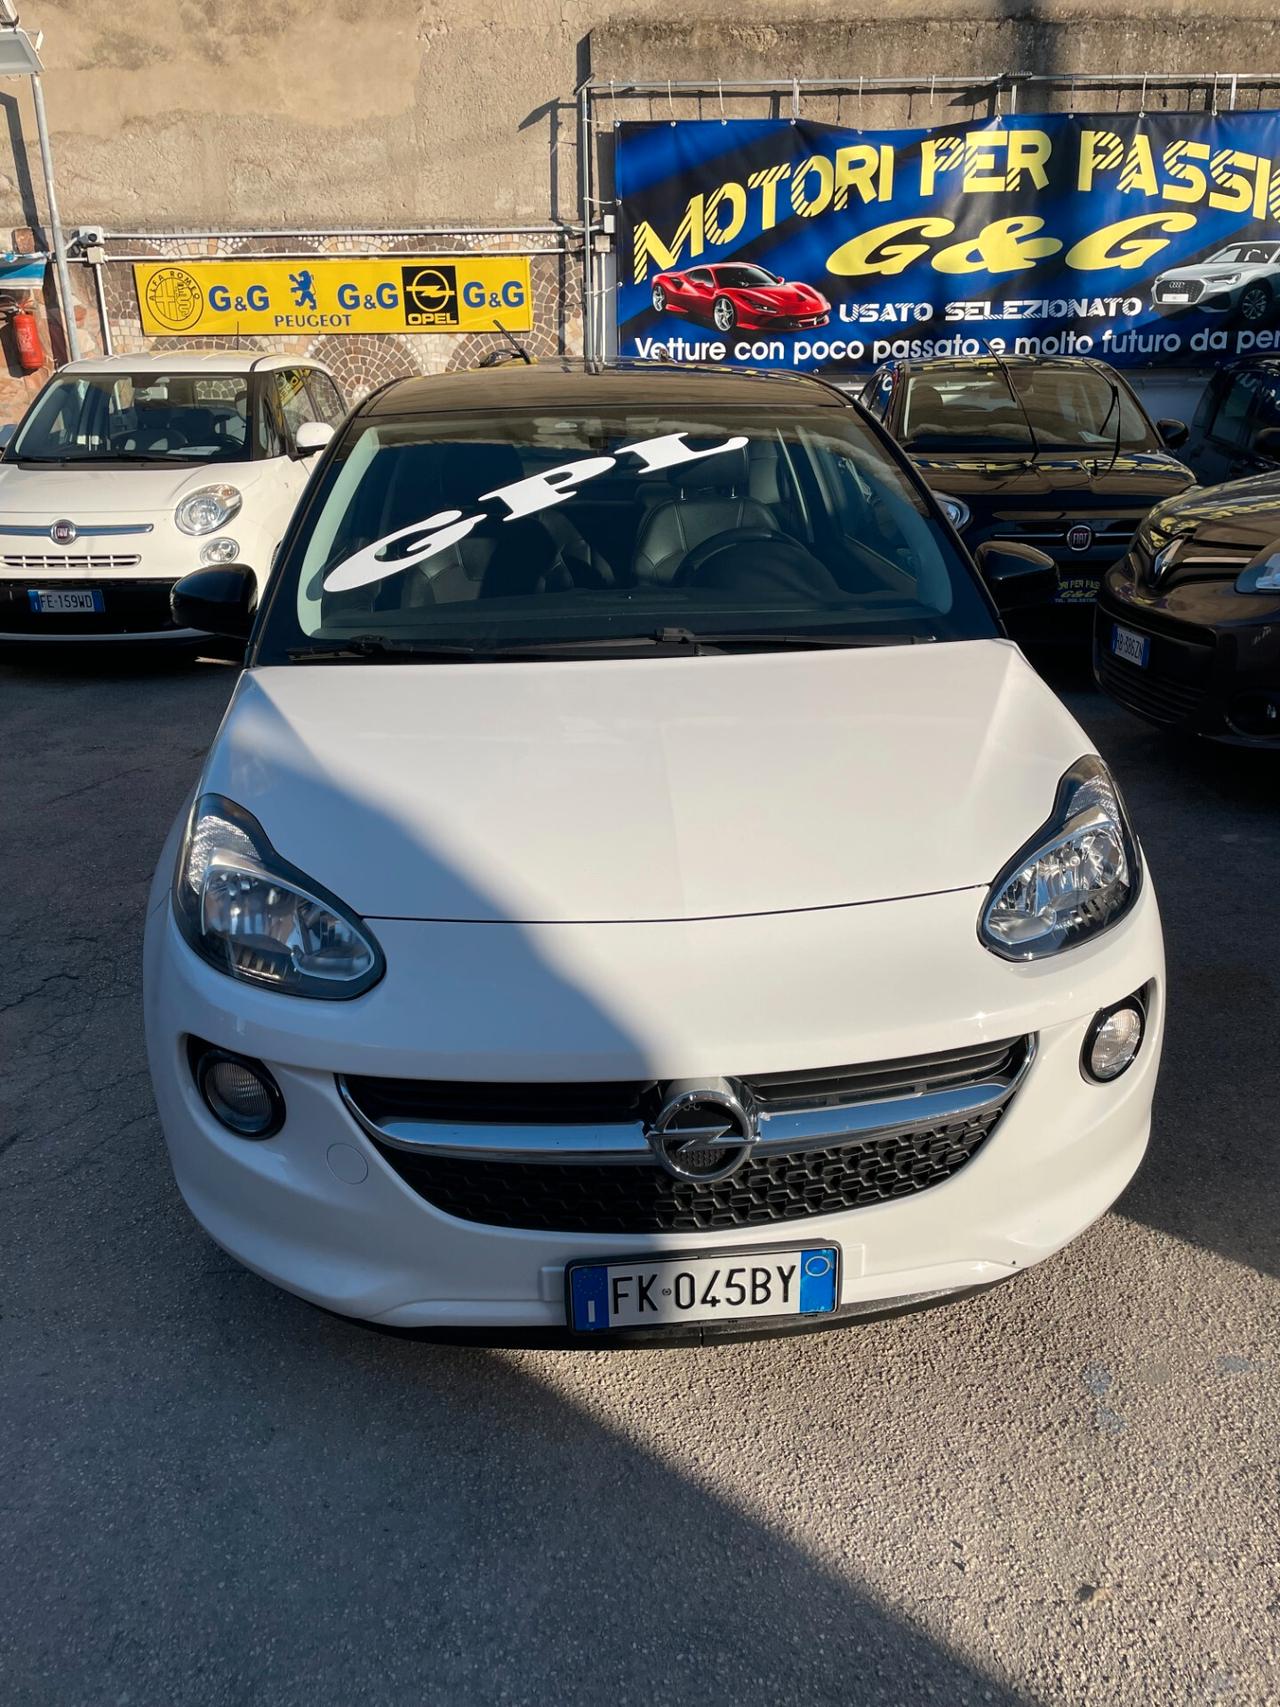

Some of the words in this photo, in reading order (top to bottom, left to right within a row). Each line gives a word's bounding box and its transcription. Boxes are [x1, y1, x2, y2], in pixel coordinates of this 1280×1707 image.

[633, 144, 894, 285] MOTORI
[919, 129, 1052, 197] PER
[1077, 130, 1280, 223] PASSI
[825, 212, 1198, 276] G&G
[148, 274, 165, 301] ALFA
[170, 270, 200, 301] ROMEO
[208, 285, 270, 312] G&G
[337, 282, 399, 310] G&G
[463, 281, 525, 309] G&G
[274, 314, 352, 328] PEUGEOT
[407, 313, 458, 325] OPEL
[839, 302, 934, 323] USATO
[945, 296, 1143, 321] SELEZIONATO
[634, 336, 727, 361] Vetture
[734, 340, 785, 361] con
[794, 338, 865, 365] poco
[873, 333, 980, 363] passato
[986, 337, 1006, 355] e
[1014, 330, 1094, 355] molto
[1101, 329, 1182, 353] futuro
[1190, 327, 1228, 352] da
[323, 432, 749, 592] GPL
[1072, 532, 1088, 545] FIAT
